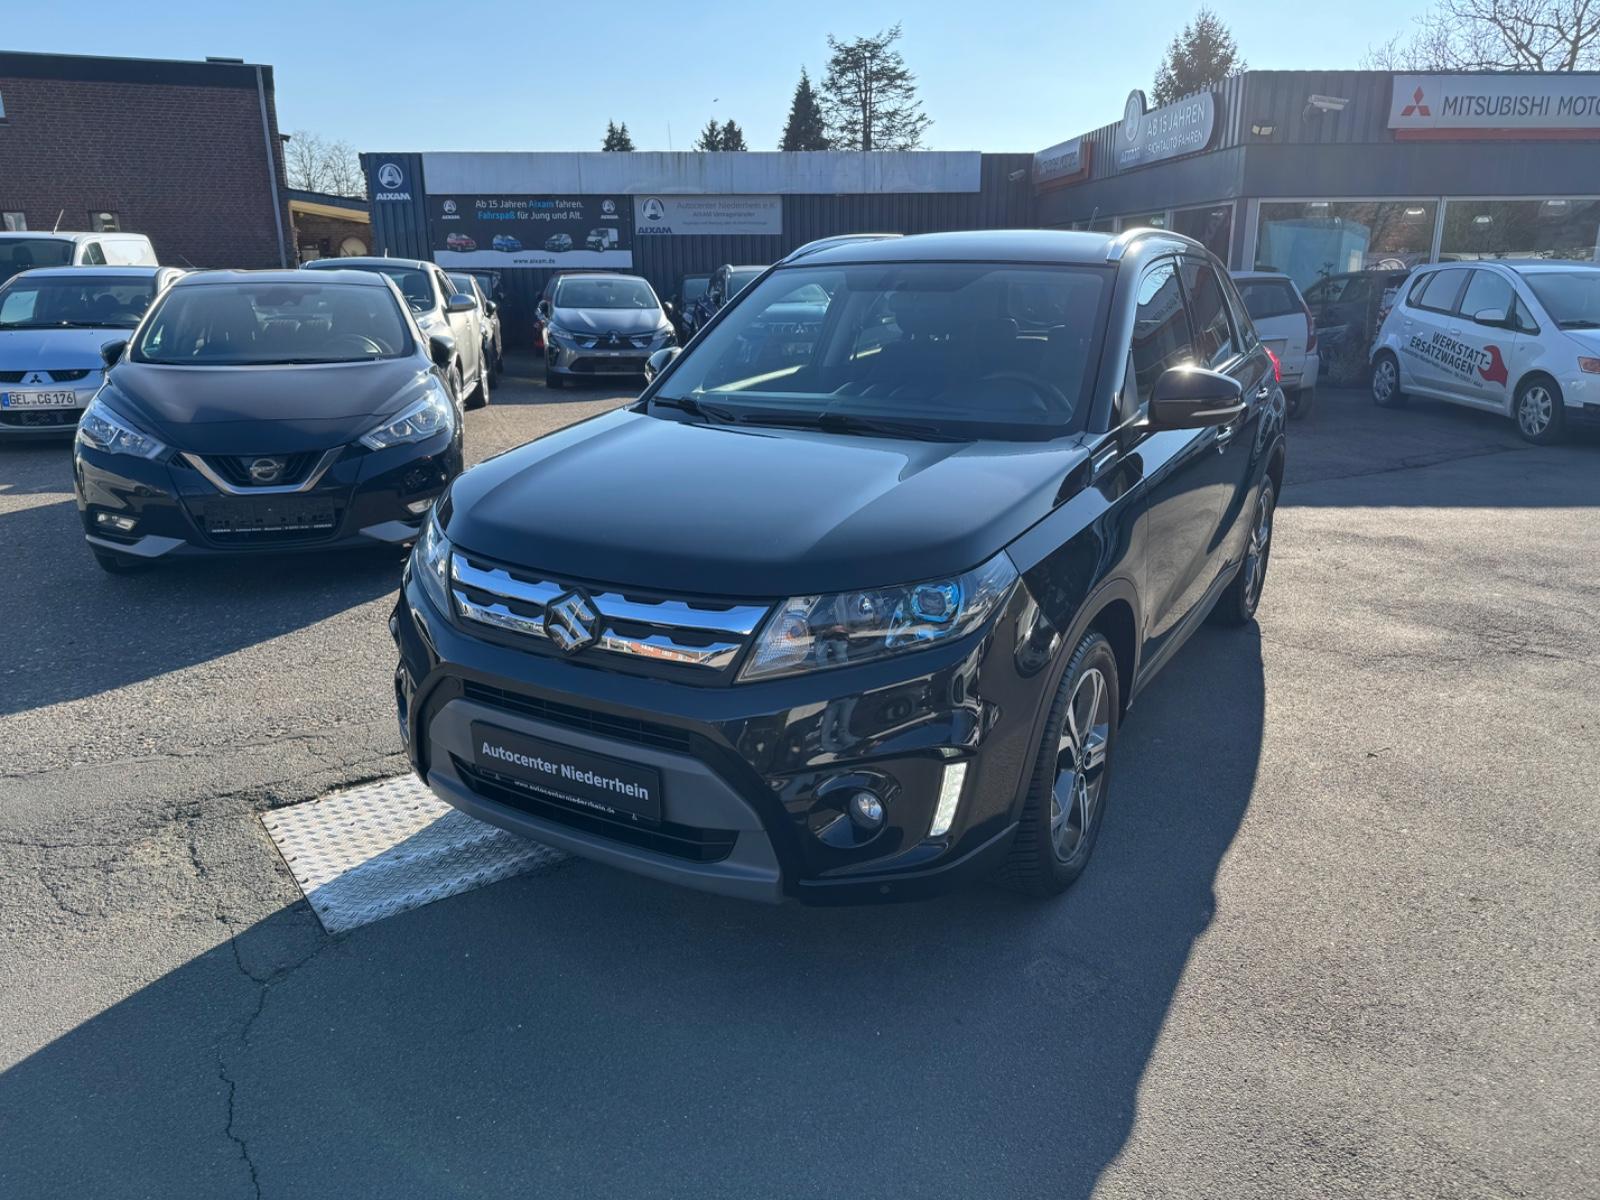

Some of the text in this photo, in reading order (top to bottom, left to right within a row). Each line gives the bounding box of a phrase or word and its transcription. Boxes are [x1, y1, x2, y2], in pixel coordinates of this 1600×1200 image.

[1441, 95, 1551, 117] MITSUBISHI
[1147, 102, 1205, 137] AB 15 JAHREN
[376, 192, 411, 201] AIXAM
[475, 200, 584, 208] Ab 15 Jahren Aixam fahren.
[478, 211, 583, 222] Fahrspaß für Jung und Alt.
[637, 226, 673, 234] AIXAM
[1409, 336, 1475, 376] ERSATZWAGEN
[1432, 331, 1490, 366] WERKSTATT-
[9, 393, 74, 406] GEL CG 176
[481, 741, 649, 801] Autocenter Niederrhein
